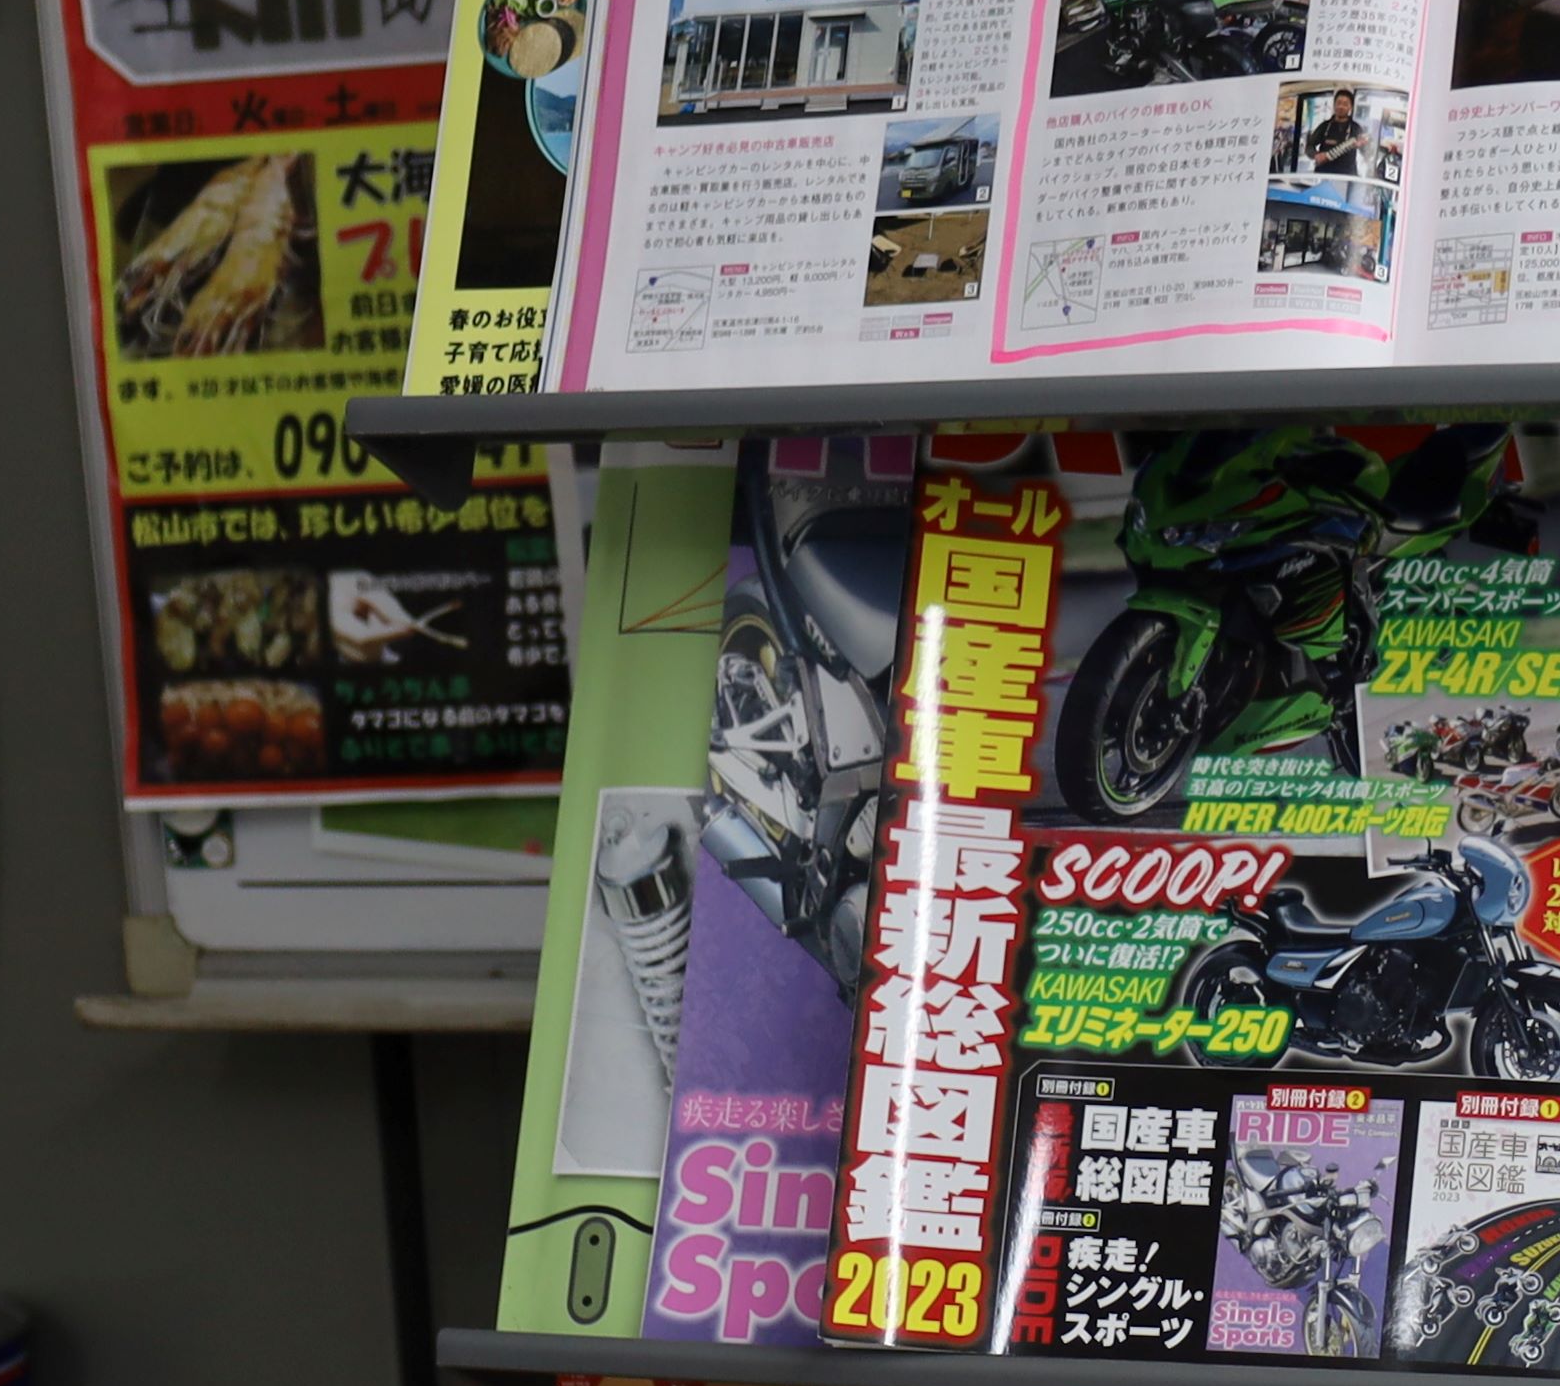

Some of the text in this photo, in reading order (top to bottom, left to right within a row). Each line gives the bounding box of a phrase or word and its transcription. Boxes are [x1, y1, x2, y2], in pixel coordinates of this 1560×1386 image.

[1045, 98, 1214, 130] 他店購入のバイクの修理もOK
[922, 478, 1062, 537] オール
[1378, 620, 1522, 647] KAWASAKI
[1191, 757, 1331, 778] 時代を突き抜けた
[1183, 803, 1451, 838] HYPER 400スポーツ烈伝
[844, 532, 1054, 1253] 国産車最新総図鑑
[1039, 844, 1286, 909] SCOOP!
[1036, 942, 1185, 972] ついに復活!?
[1029, 972, 1167, 1003] KAWASAKI
[1023, 1006, 1289, 1053] エリミネーター250
[1270, 1088, 1343, 1110] 別冊付録
[1457, 1095, 1539, 1117] 別冊付録
[1080, 1105, 1218, 1155] 国産車
[1236, 1111, 1350, 1146] RIDE
[1075, 1157, 1214, 1206] 総図鑑
[1067, 1237, 1162, 1272] 疾走!
[832, 1252, 982, 1336] 2023
[1060, 1314, 1194, 1349] スポーツ
[1212, 1301, 1295, 1327] Single
[1209, 1325, 1295, 1349] Sports
